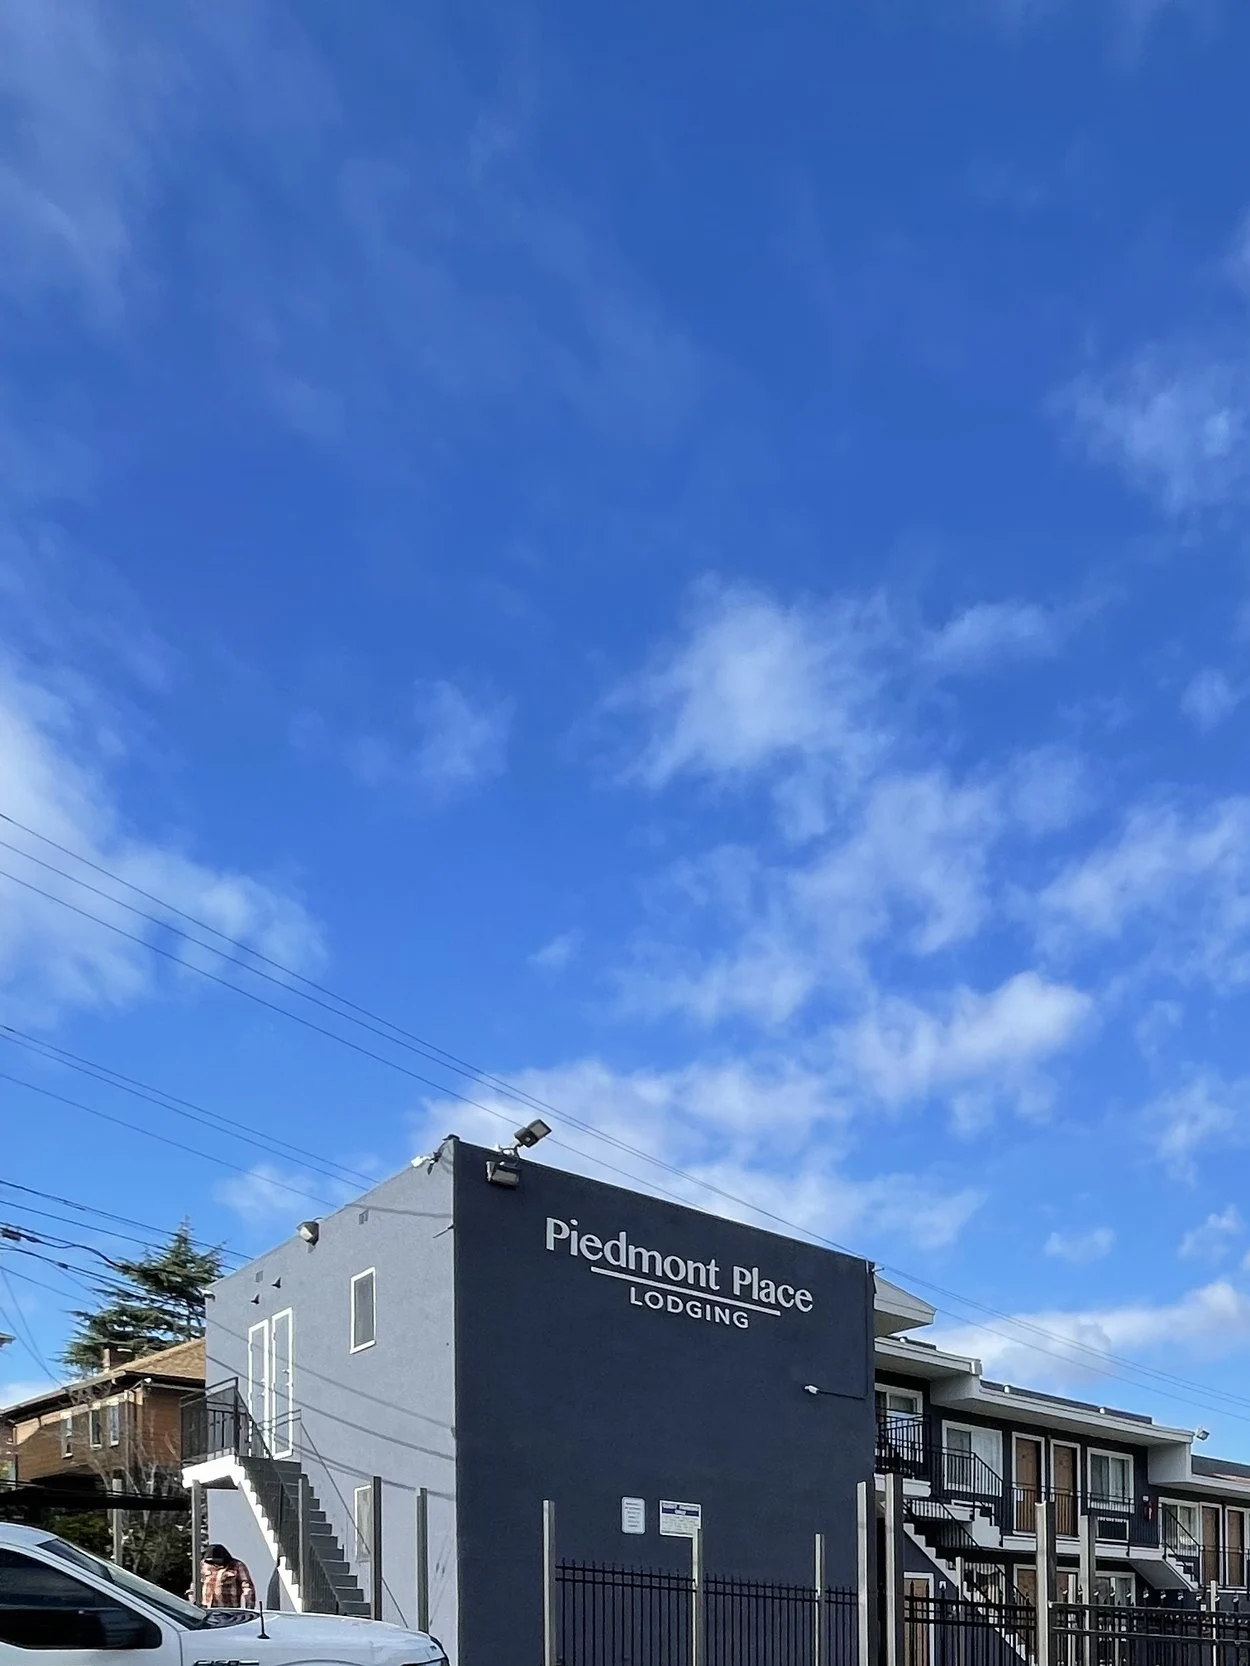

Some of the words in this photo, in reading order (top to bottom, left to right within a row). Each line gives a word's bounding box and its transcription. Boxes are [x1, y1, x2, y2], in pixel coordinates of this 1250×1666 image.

[545, 1217, 720, 1291] Piedmont
[732, 1265, 813, 1313] Place
[629, 1286, 749, 1329] LODGING
